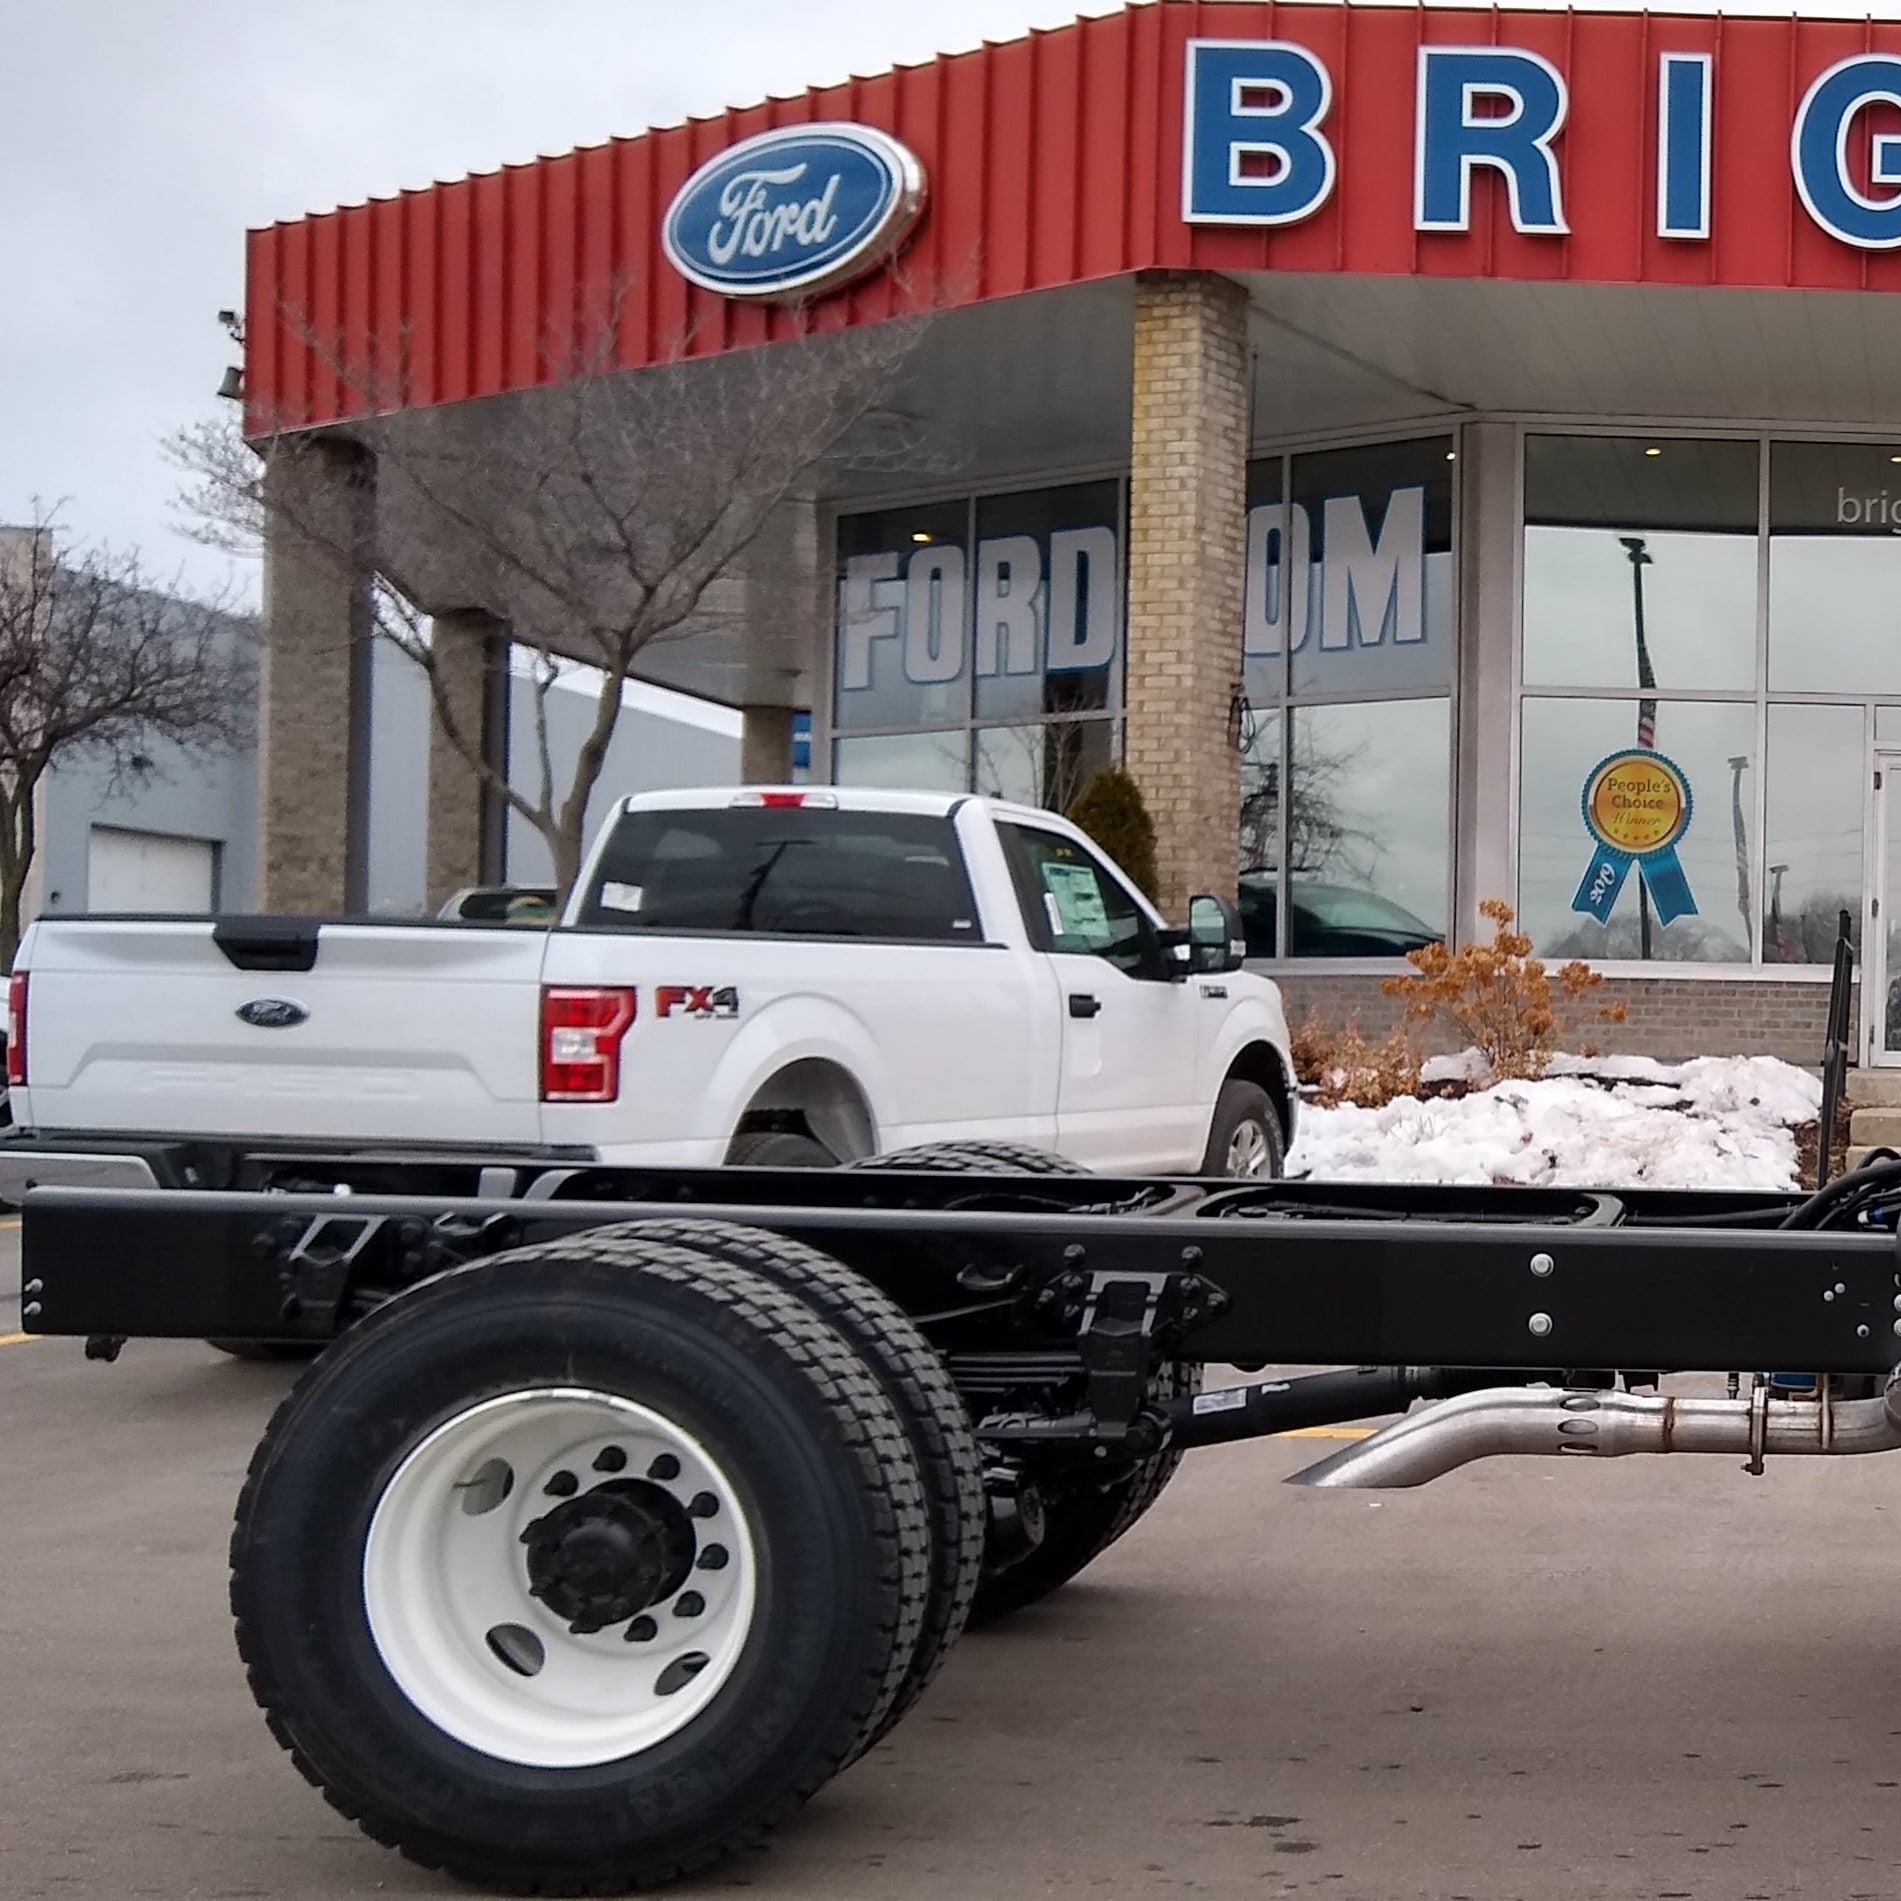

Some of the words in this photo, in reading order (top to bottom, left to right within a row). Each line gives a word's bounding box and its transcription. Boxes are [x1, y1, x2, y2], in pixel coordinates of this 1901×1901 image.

[708, 162, 841, 265] Ford
[1607, 777, 1671, 795] People's
[1611, 795, 1664, 809] Choice
[1613, 812, 1660, 825] Winner
[656, 986, 738, 1017] FX4
